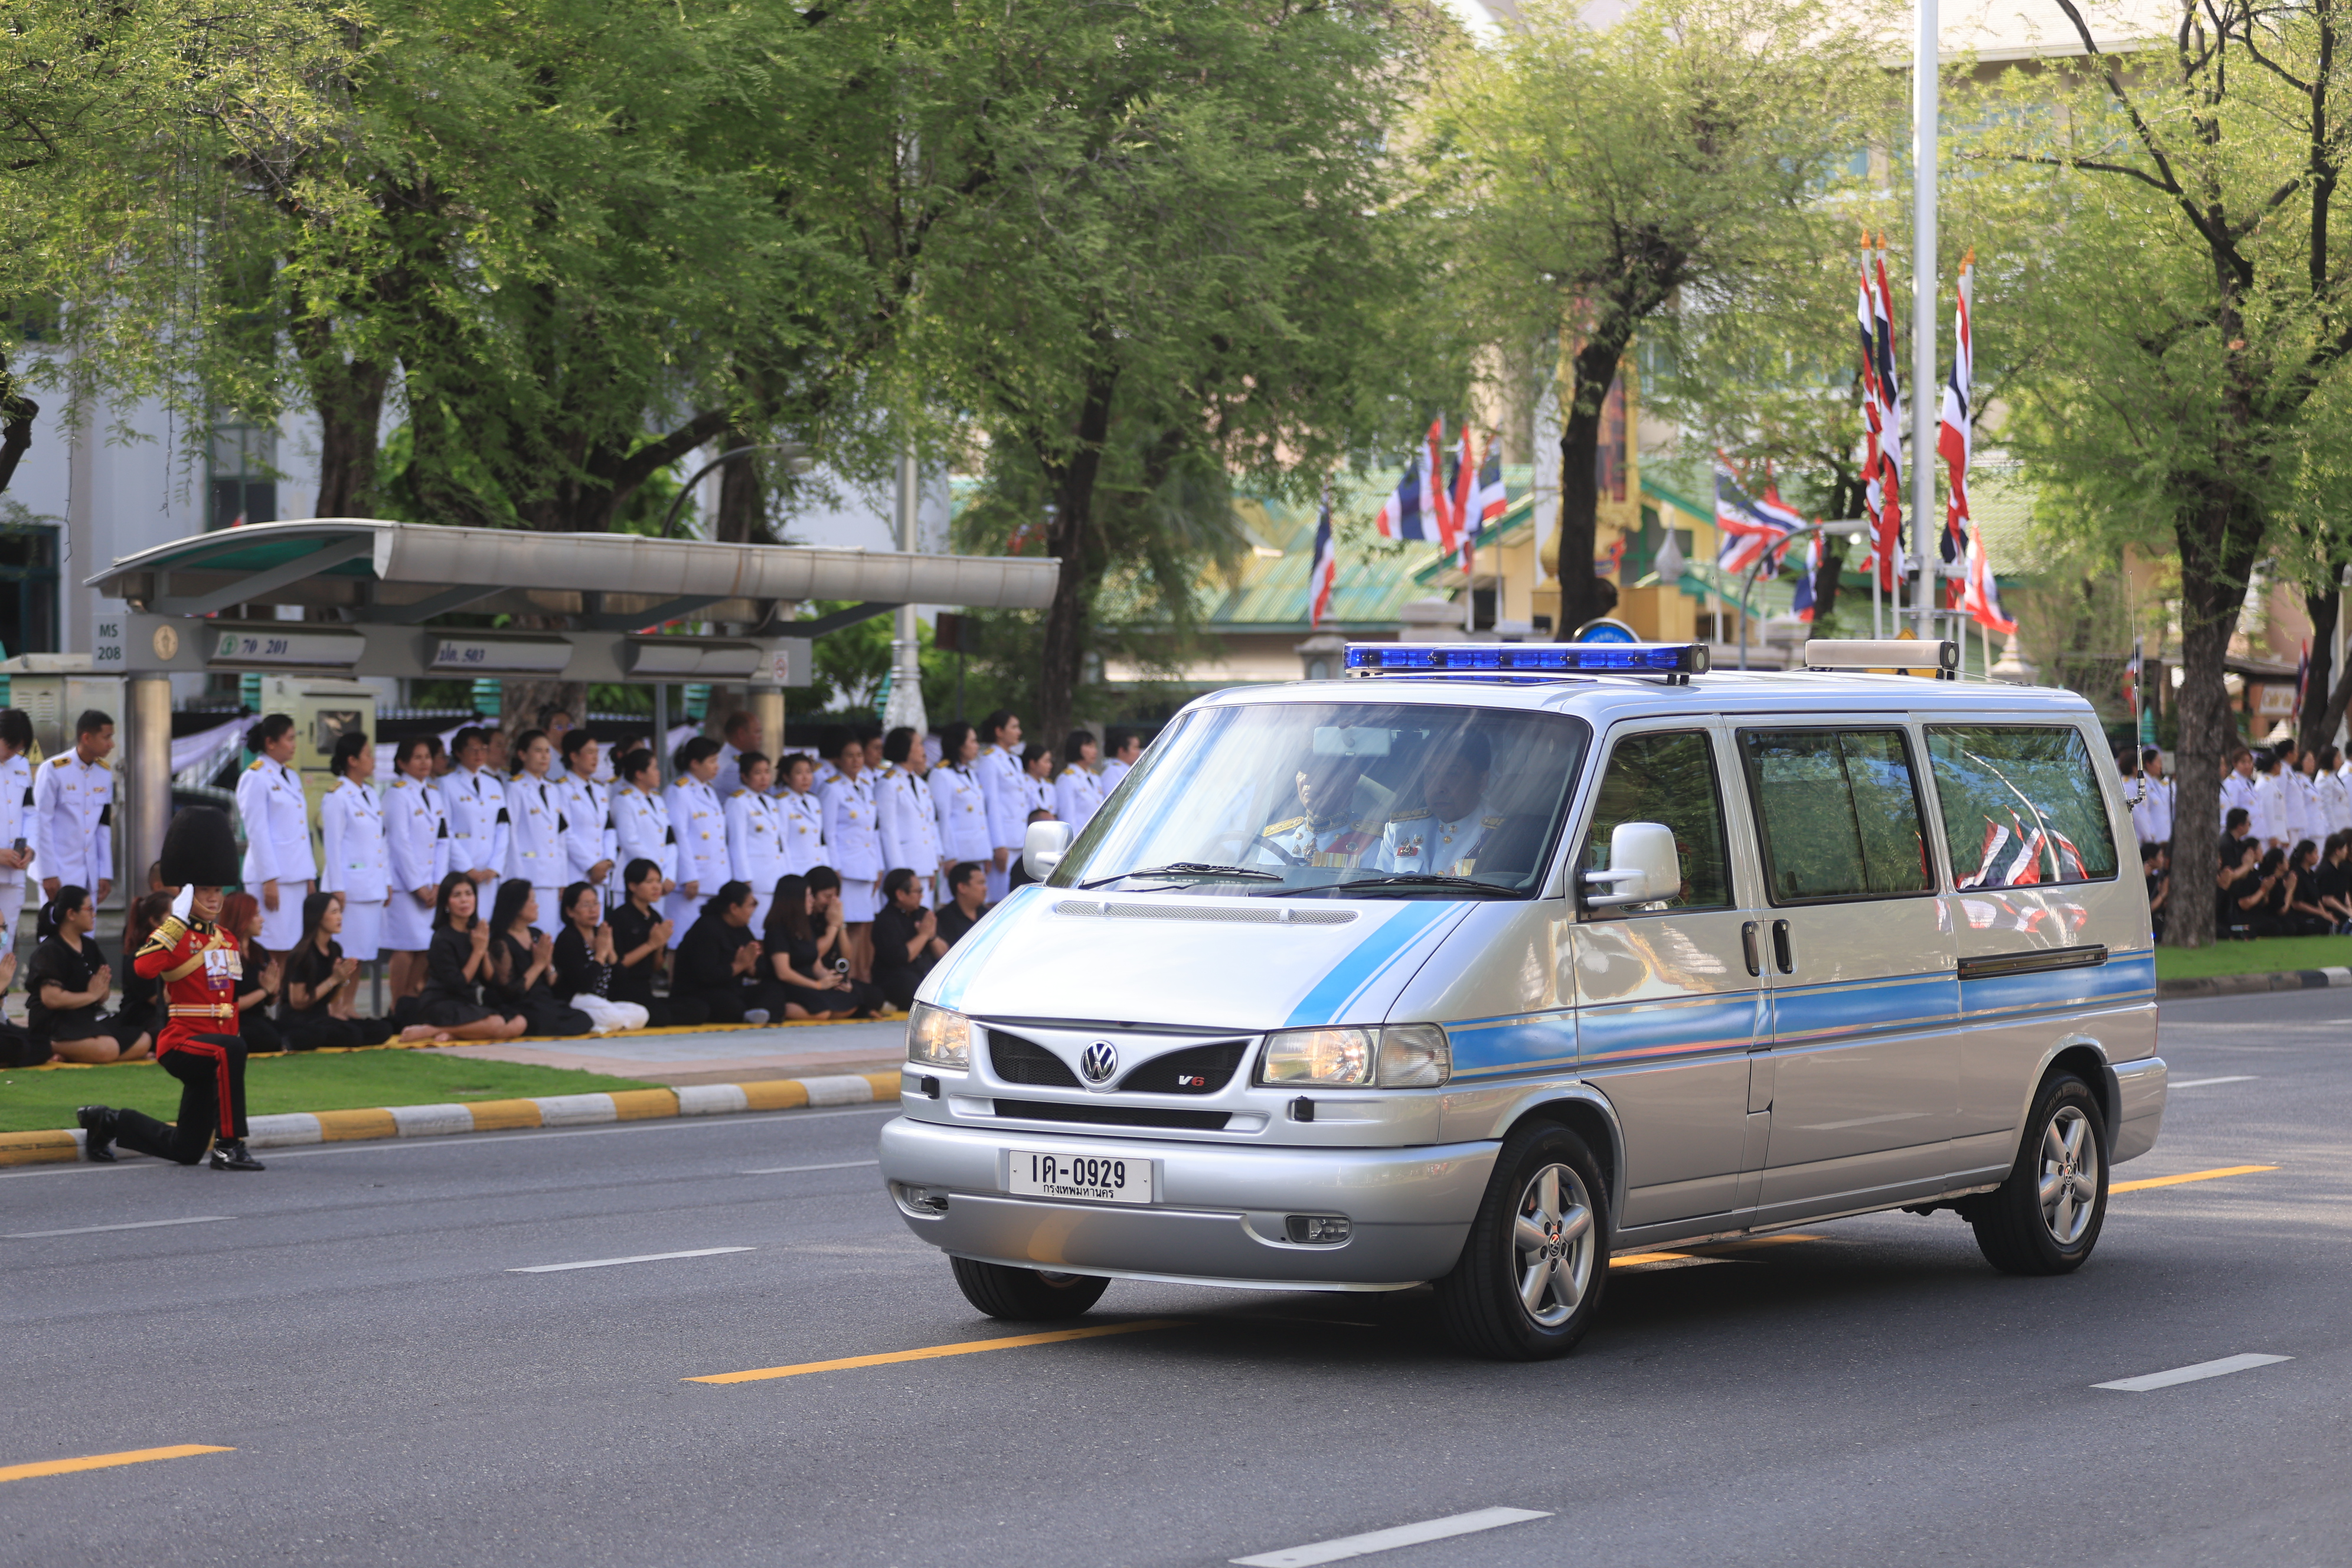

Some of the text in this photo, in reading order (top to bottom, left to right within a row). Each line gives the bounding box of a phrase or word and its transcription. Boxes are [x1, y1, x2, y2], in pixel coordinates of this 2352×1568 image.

[99, 623, 118, 637] MS
[98, 646, 122, 660] 208
[243, 638, 288, 655] 70 201
[1178, 1075, 1205, 1086] V6
[1043, 1184, 1114, 1198] กรุงเทพมหานคร
